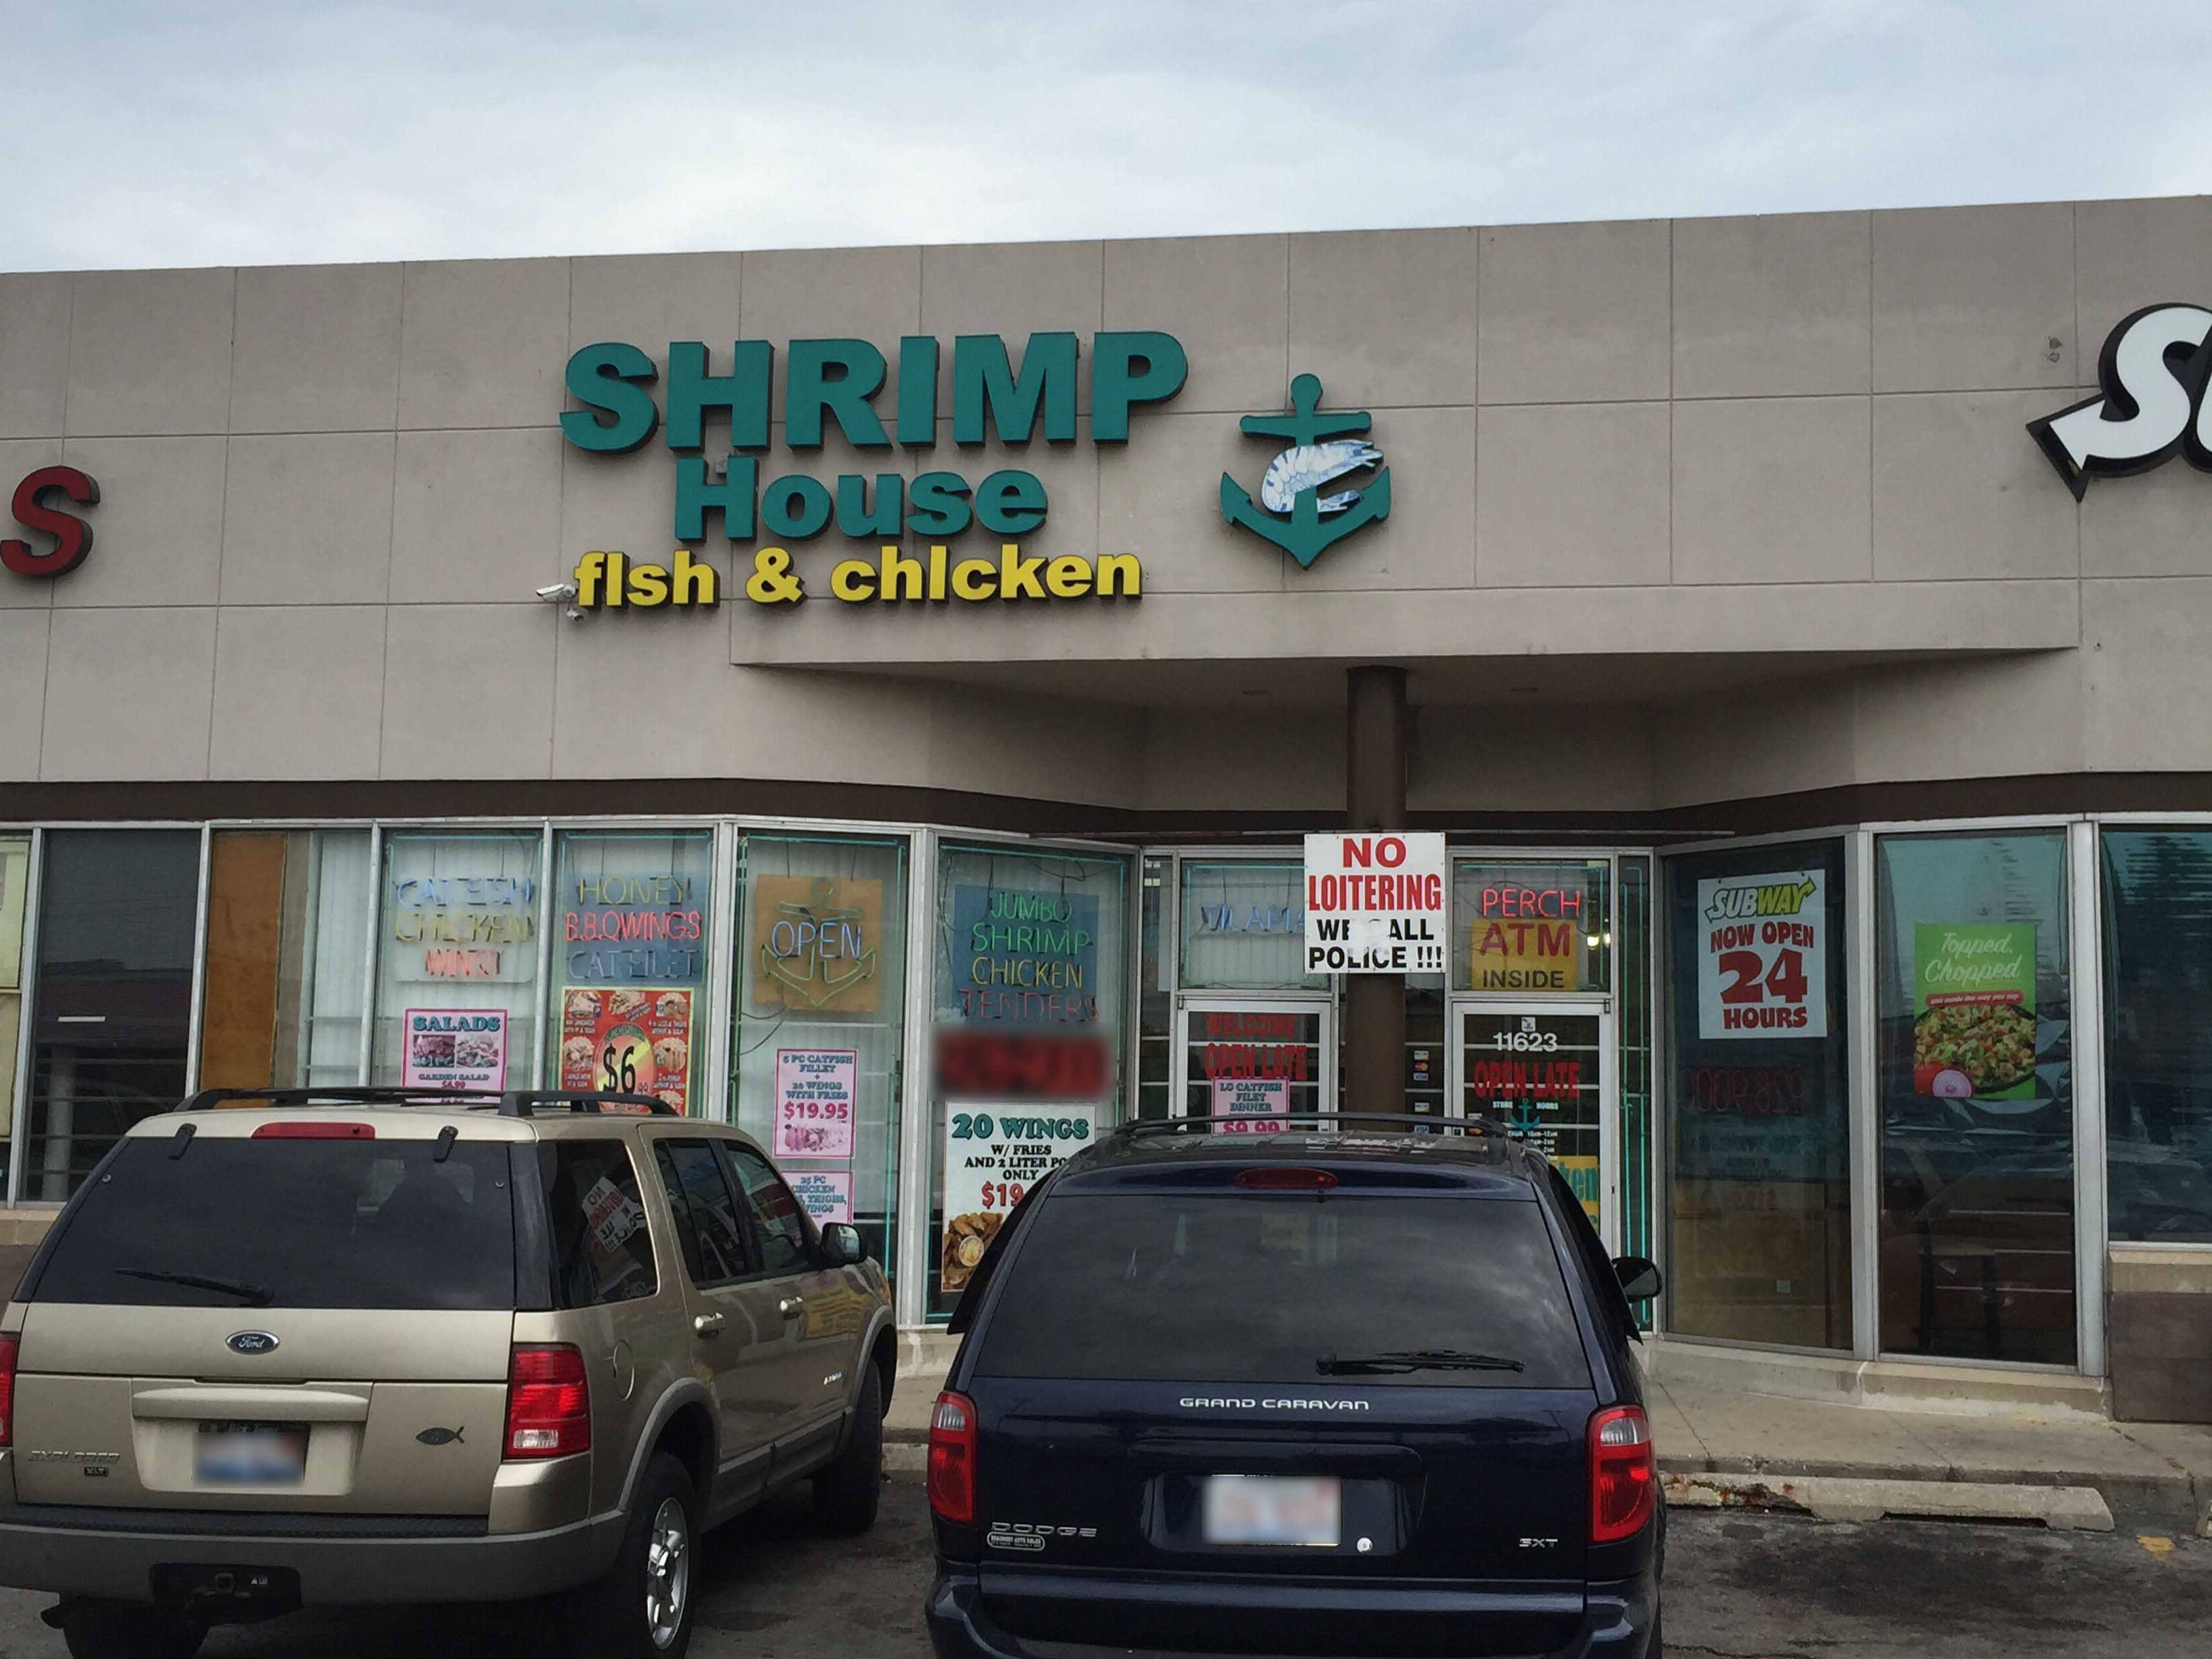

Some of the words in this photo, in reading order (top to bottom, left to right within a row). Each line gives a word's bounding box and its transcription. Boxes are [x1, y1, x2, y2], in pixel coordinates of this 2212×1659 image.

[560, 331, 1189, 453] SHRIMP
[674, 455, 1048, 541] House
[0, 466, 100, 577] S
[746, 547, 806, 606] &
[1343, 837, 1406, 868] NO
[578, 877, 690, 906] HONEY
[1309, 874, 1441, 911] LOITERING
[1481, 888, 1582, 918] PERCH
[1704, 879, 1816, 922] SUBWAY
[991, 892, 1073, 922] JUMBO
[396, 914, 533, 943] CHICKEN
[771, 920, 862, 960] OPEN
[971, 922, 1092, 956] SHRIMP
[1369, 918, 1434, 941] ALL
[1479, 922, 1572, 956] ATM
[1711, 924, 1755, 953] NOW
[1762, 921, 1814, 949] OPEN
[972, 956, 1082, 988] CHICKEN
[1483, 970, 1565, 988] INSIDE
[1719, 948, 1807, 1004] 24
[1925, 954, 2023, 987] Chopped
[958, 988, 1099, 1022] TENDERS
[1723, 1007, 1808, 1029] HOURS
[413, 1016, 501, 1032] SALADS
[1206, 1012, 1297, 1038] WELCOME
[1493, 1032, 1558, 1052] 11623
[1205, 1042, 1256, 1080] OPEN
[1261, 1044, 1308, 1081] LATE
[1235, 1083, 1282, 1092] CATFISH
[1474, 1060, 1528, 1098] OPEN
[1532, 1061, 1581, 1099] LATE
[786, 1090, 815, 1099] WITH
[784, 1101, 848, 1120] $19.95
[951, 1113, 994, 1140] 20
[1000, 1118, 1089, 1140] WINGS
[964, 1156, 995, 1168] AND
[998, 1158, 1006, 1168] 2
[1009, 1157, 1047, 1168] LITER
[1050, 1157, 1069, 1168] PO
[991, 1144, 1009, 1157] W/
[1012, 1145, 1052, 1155] FRIES
[1002, 1169, 1040, 1181] ONLY
[981, 1181, 1024, 1209] $19
[239, 1335, 266, 1349] Ford
[1179, 1398, 1256, 1408] GRAND
[1261, 1399, 1370, 1410] CARAVAN
[85, 1467, 106, 1475] XLT
[991, 1521, 1097, 1537] DODGE
[1519, 1538, 1558, 1548] SXT
